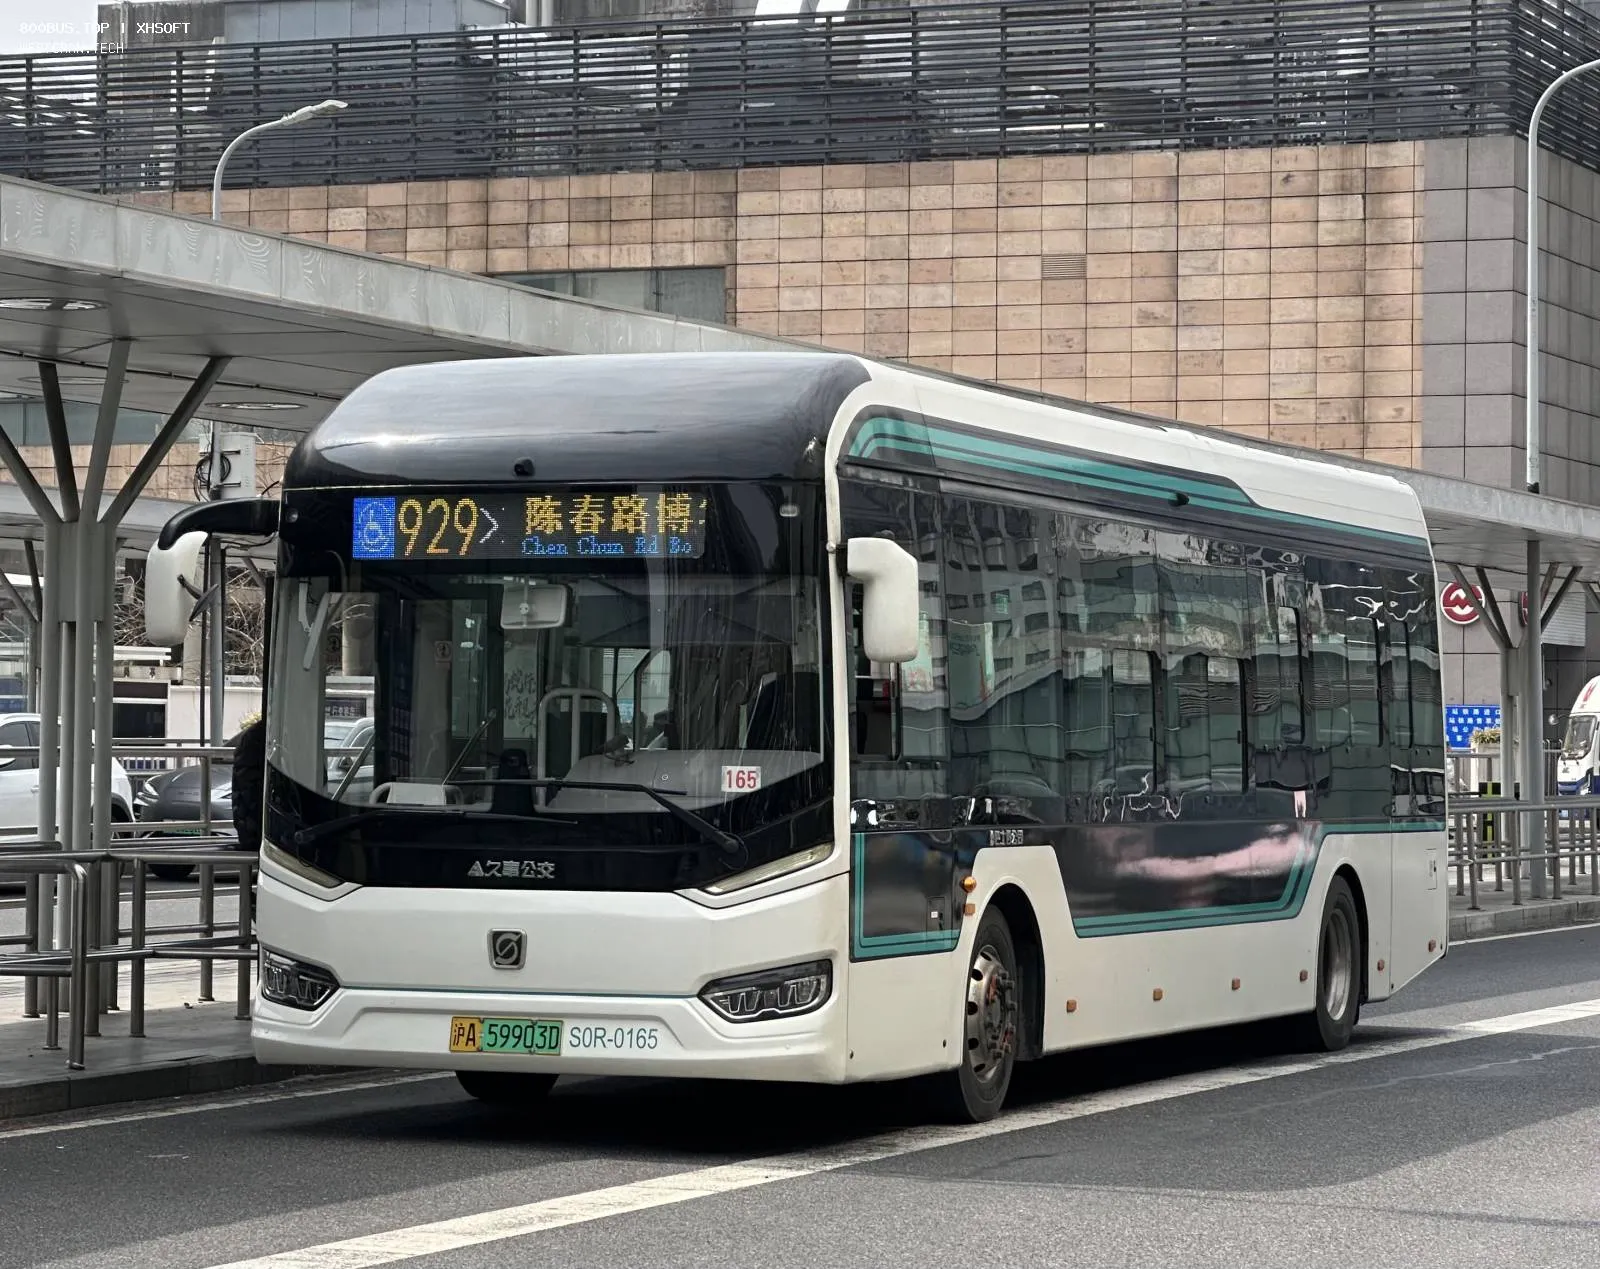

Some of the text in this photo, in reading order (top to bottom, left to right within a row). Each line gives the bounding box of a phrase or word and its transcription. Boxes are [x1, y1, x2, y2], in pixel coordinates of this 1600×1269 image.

[525, 493, 707, 534] 陈春路博
[398, 498, 479, 556] 929
[521, 535, 569, 555] Chen
[576, 535, 625, 555] Chun
[633, 535, 659, 555] Rd
[726, 769, 757, 789] 165
[484, 859, 555, 879] 久事公交
